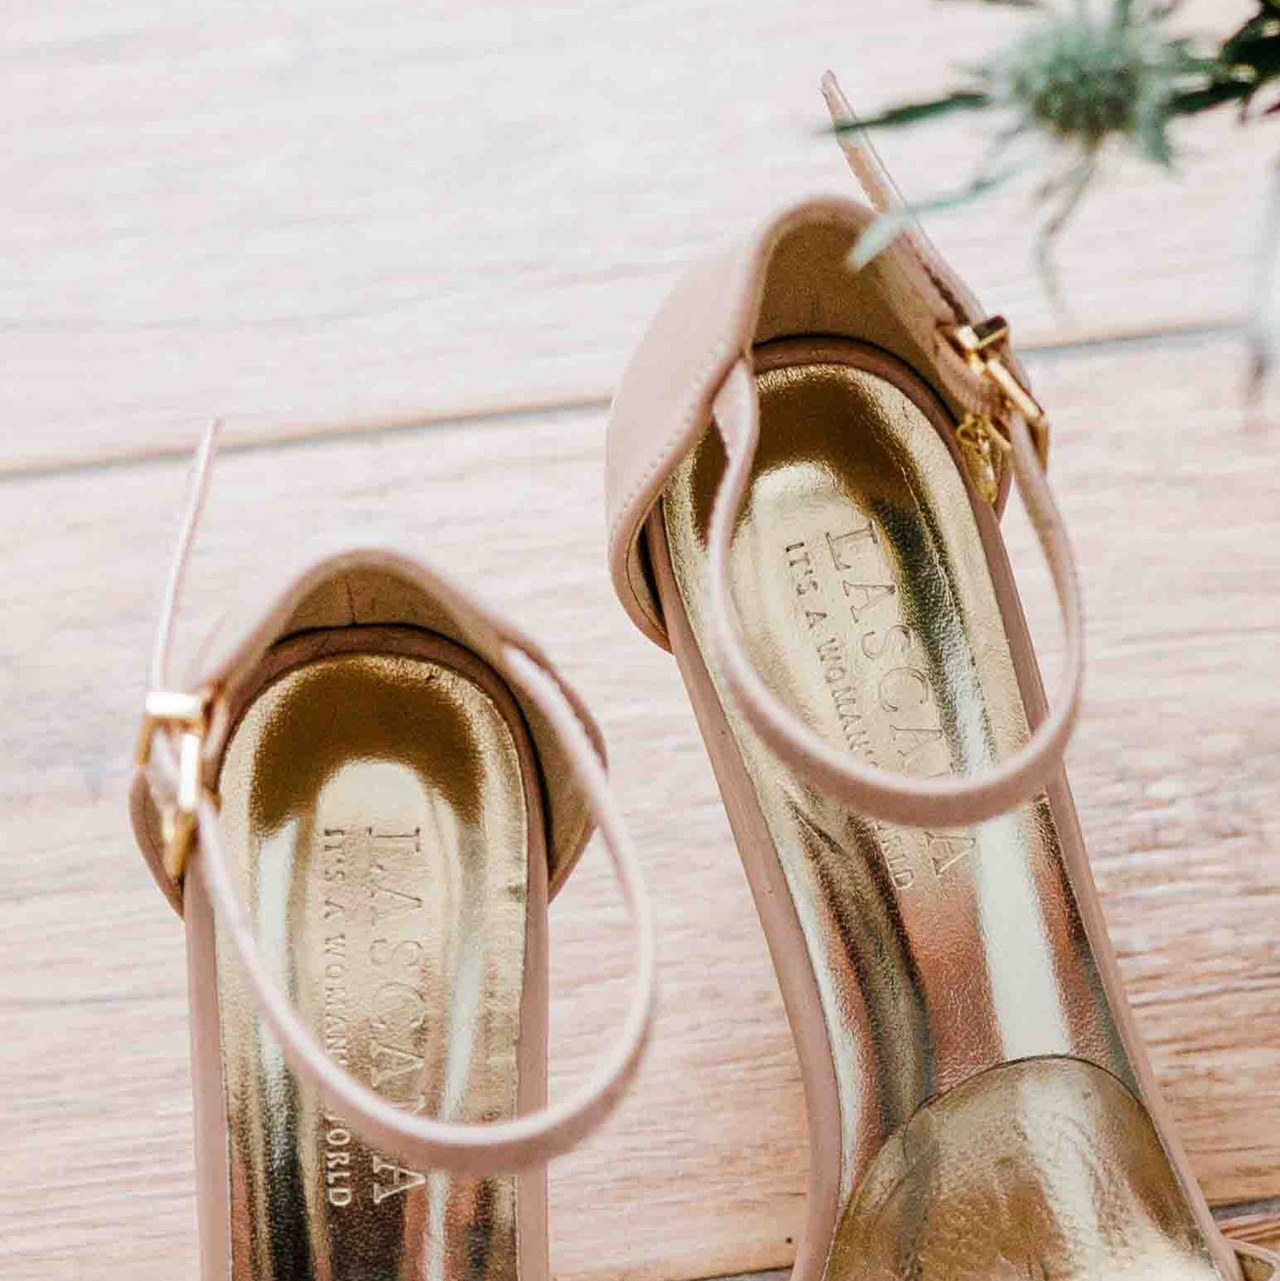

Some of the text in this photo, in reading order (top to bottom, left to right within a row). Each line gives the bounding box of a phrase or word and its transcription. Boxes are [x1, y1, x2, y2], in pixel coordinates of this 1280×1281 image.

[785, 541, 818, 596] IT'S
[804, 610, 828, 629] A
[824, 521, 976, 878] LASCAA
[324, 828, 350, 1206] IT'S A WOMAN' ORLD
